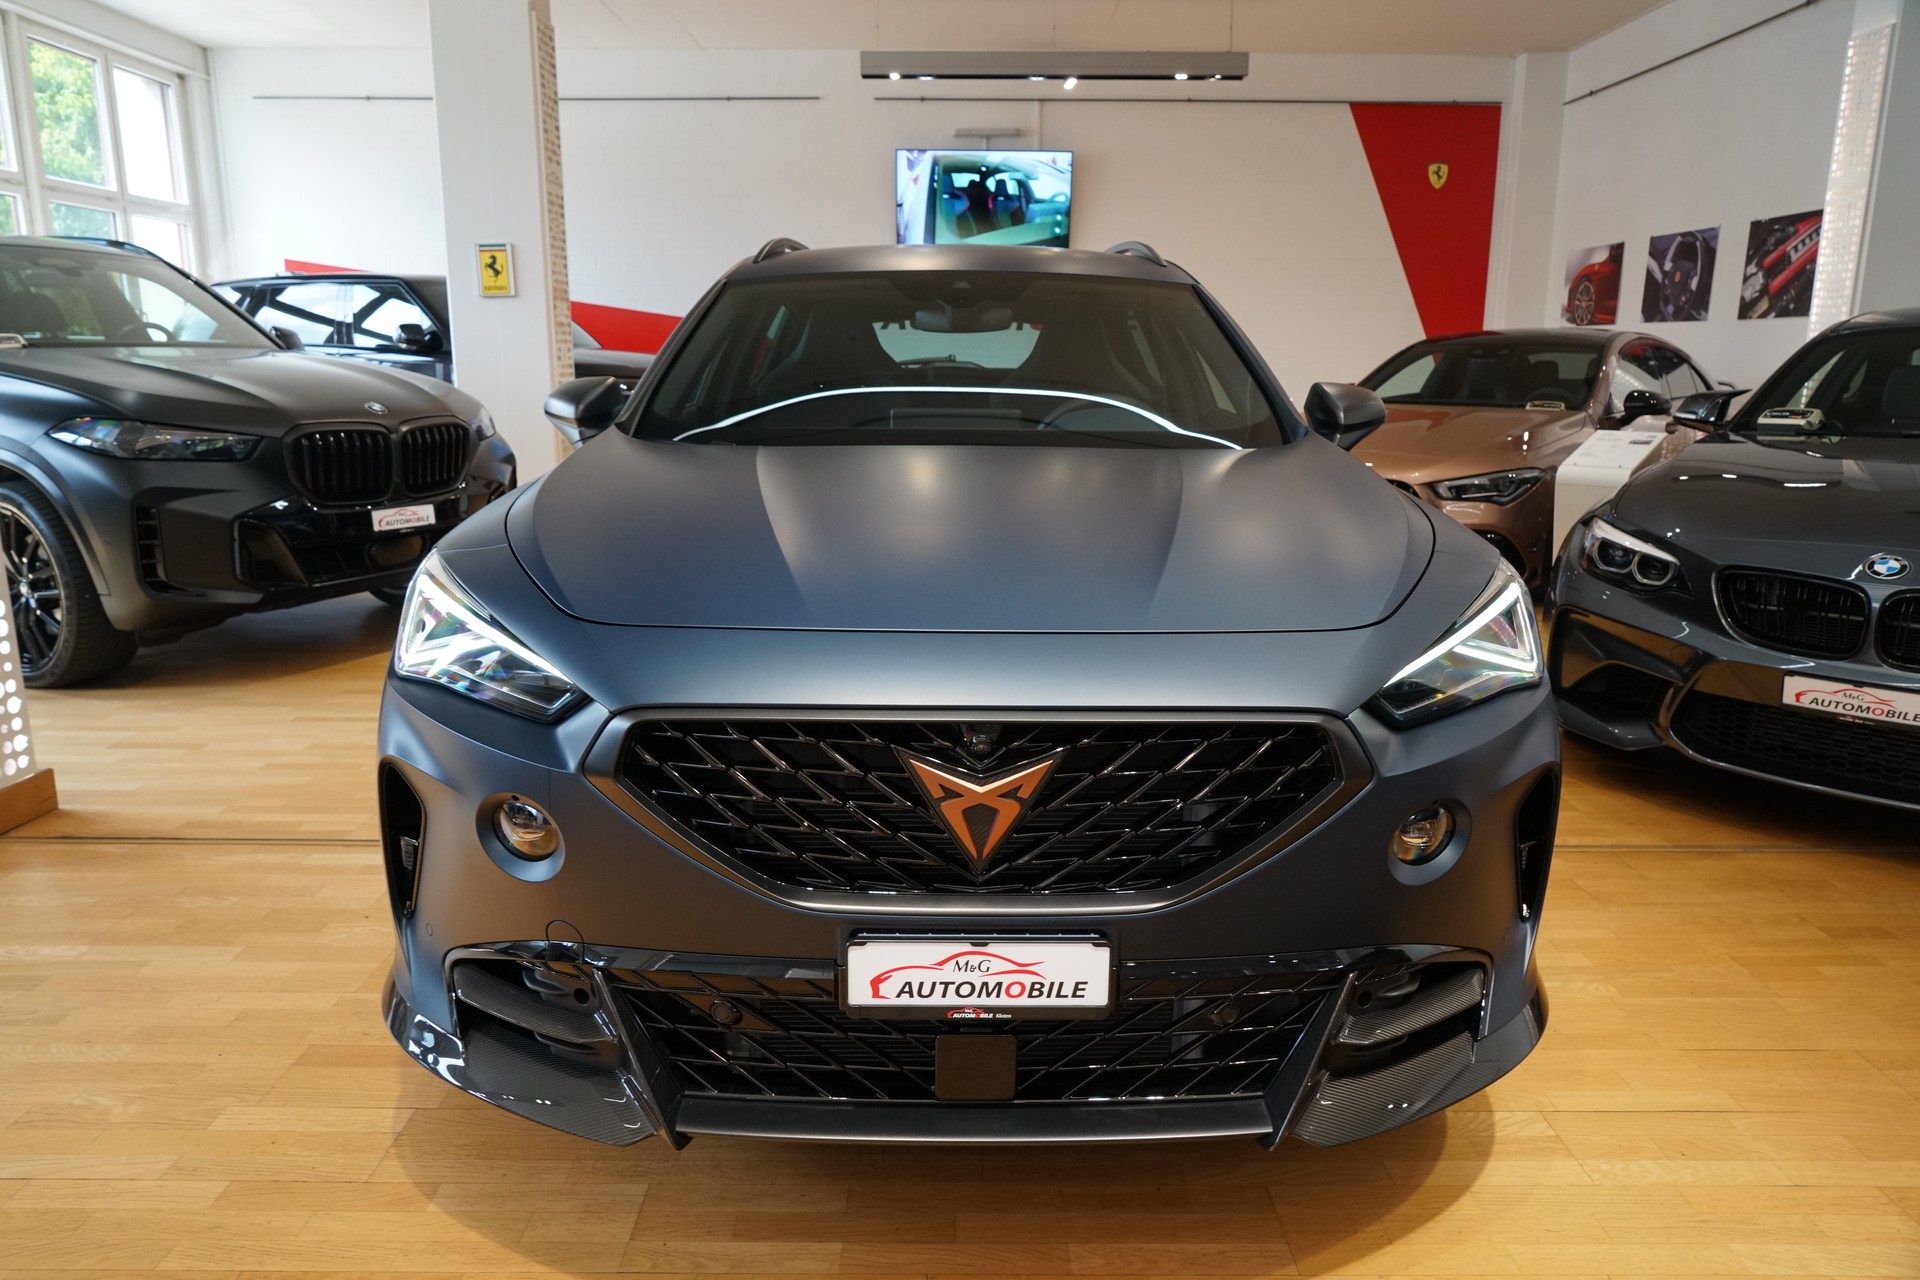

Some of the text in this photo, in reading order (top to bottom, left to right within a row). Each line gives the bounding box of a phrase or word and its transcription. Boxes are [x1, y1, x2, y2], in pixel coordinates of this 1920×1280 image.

[385, 516, 430, 527] AUTOMOBILE
[1808, 697, 1920, 723] AUTOMOBILE
[952, 959, 992, 973] M&G
[895, 981, 1089, 999] AUTOMOBILE
